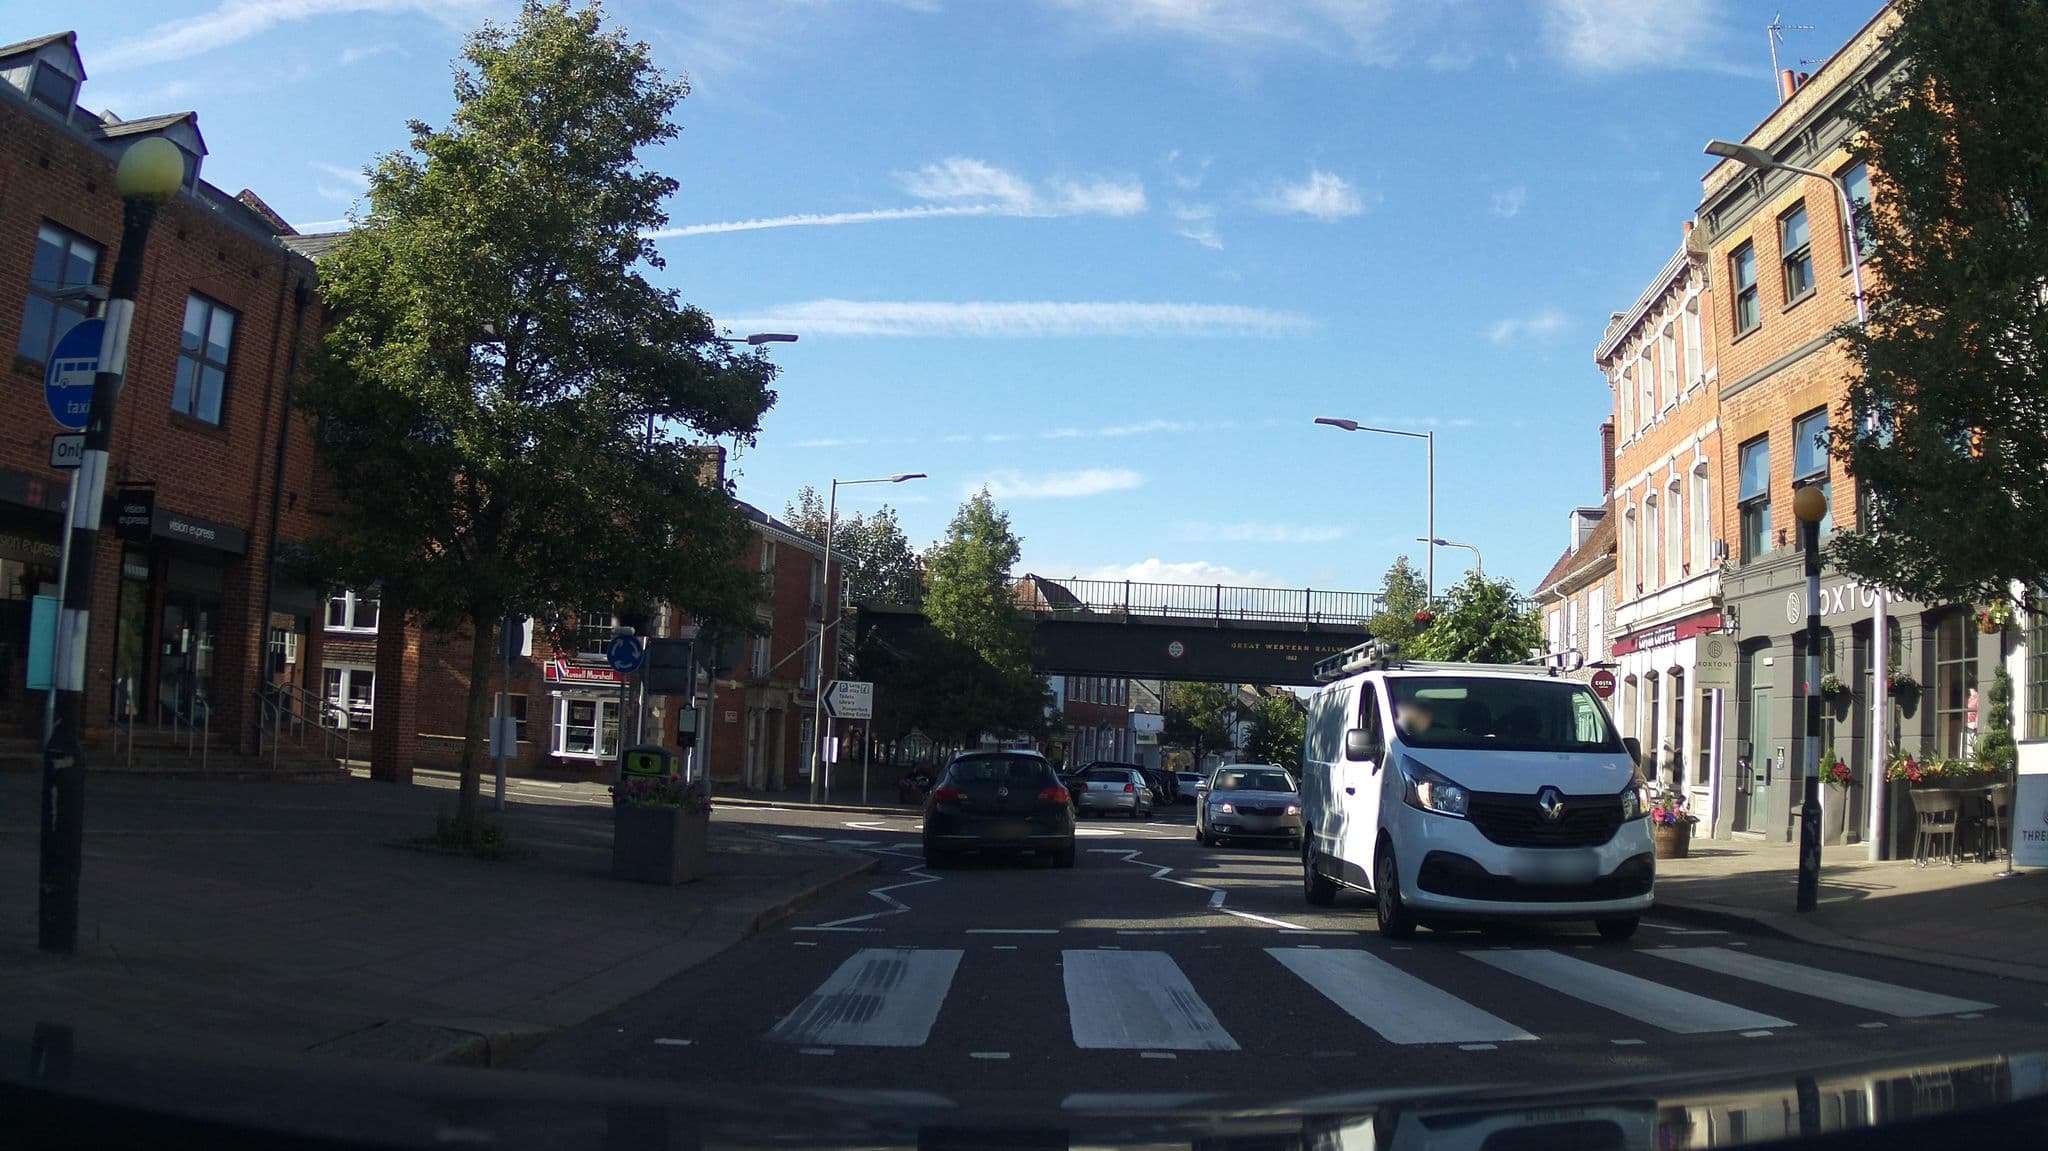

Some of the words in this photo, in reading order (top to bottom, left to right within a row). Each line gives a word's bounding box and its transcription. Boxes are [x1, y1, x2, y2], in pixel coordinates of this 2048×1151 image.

[124, 504, 146, 514] vision
[168, 521, 189, 535] vision
[1265, 643, 1309, 651] WESTERN
[1315, 645, 1349, 653] RAILW
[565, 669, 586, 679] Russell
[586, 670, 614, 681] Marshall
[2022, 830, 2048, 841] THRE
